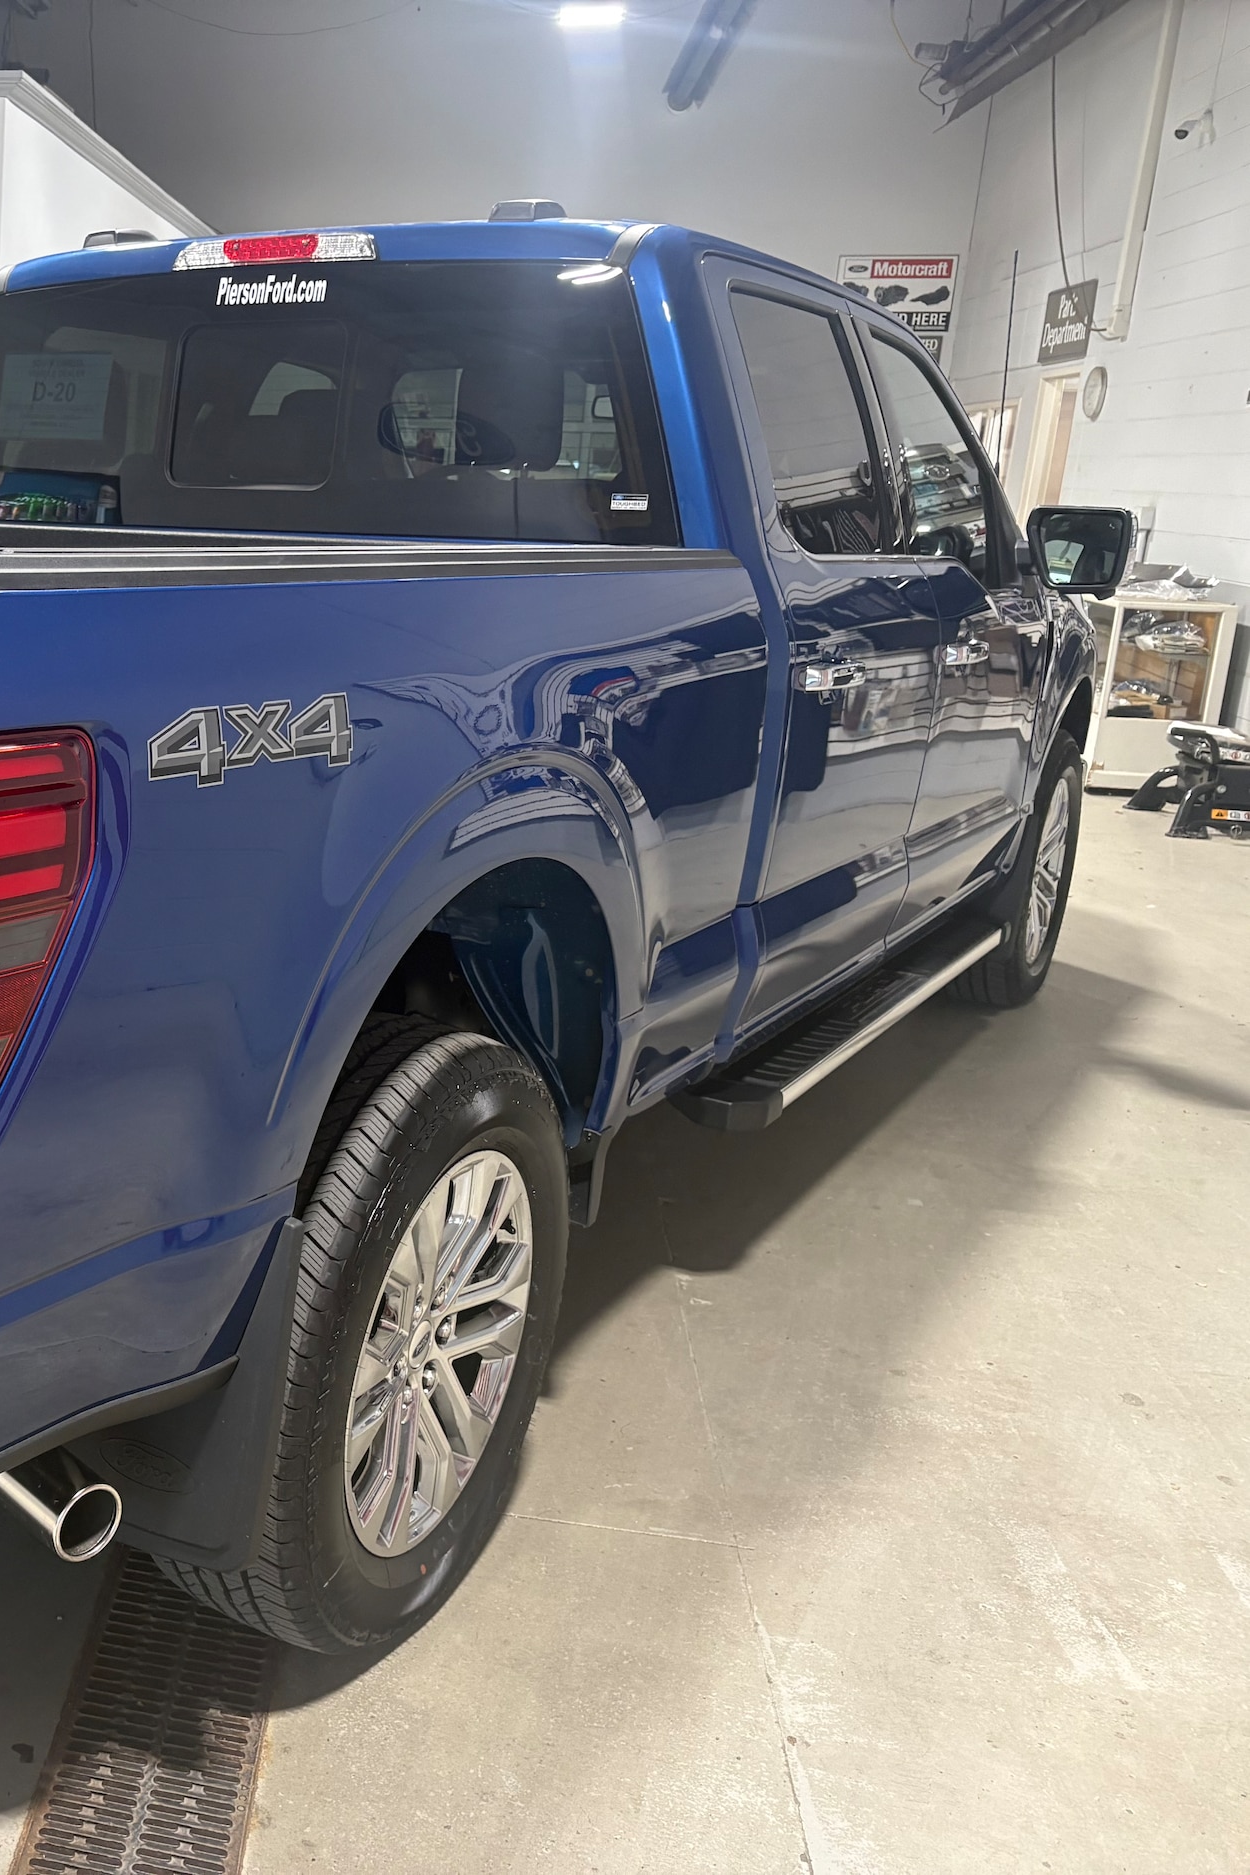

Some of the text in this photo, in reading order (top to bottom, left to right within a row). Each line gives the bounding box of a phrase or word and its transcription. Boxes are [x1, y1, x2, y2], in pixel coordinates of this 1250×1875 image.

[874, 261, 949, 277] Motorcraft
[216, 273, 328, 306] PiersonFord.com
[912, 313, 947, 325] HERE
[32, 381, 77, 402] D-20
